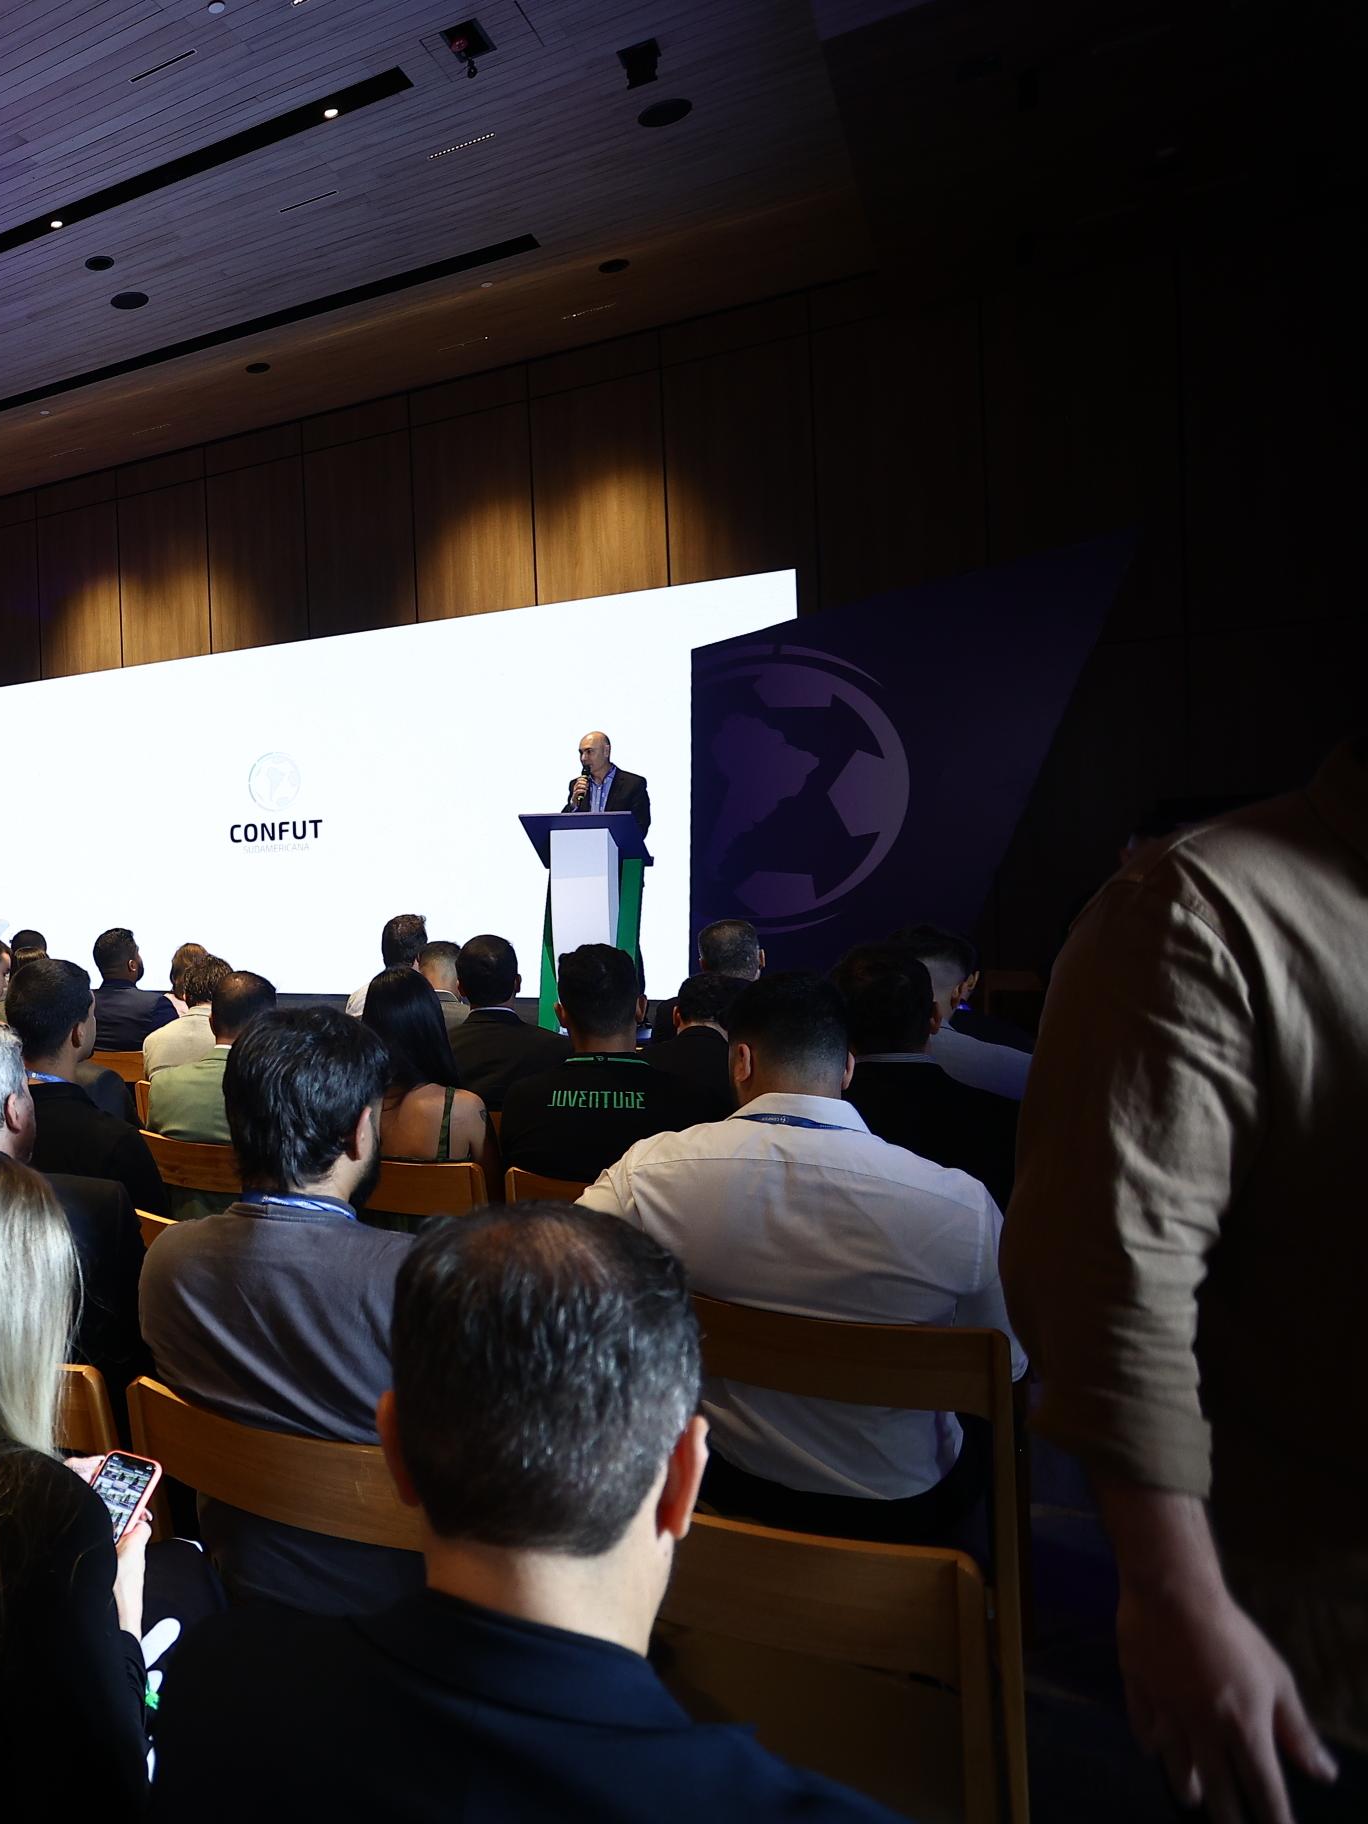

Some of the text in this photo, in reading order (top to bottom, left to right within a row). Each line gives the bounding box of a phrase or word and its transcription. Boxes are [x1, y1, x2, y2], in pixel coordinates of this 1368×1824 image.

[230, 819, 323, 843] CONFUT
[243, 842, 310, 854] SUDAMERICANA
[547, 1090, 646, 1109] JUVENTUDE
